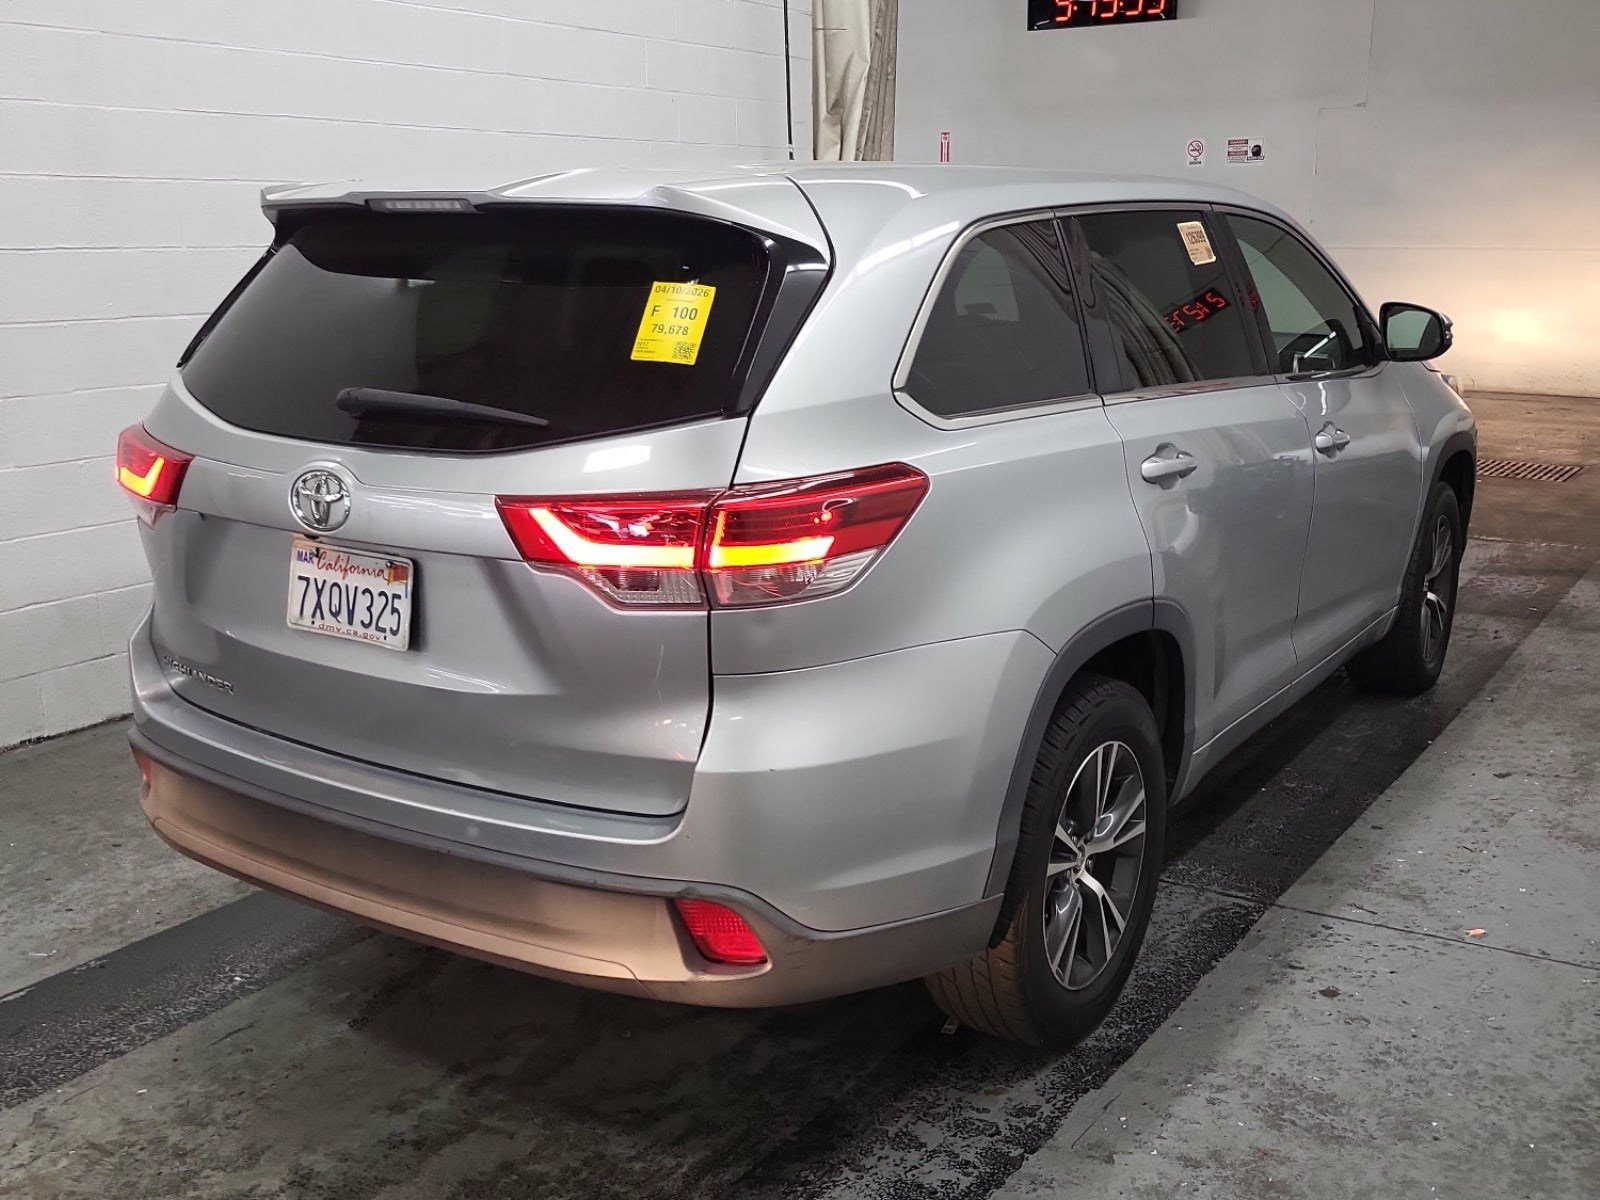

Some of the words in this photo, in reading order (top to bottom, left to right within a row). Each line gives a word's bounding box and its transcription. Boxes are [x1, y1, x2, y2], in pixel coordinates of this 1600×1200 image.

[654, 285, 710, 298] 04/10/2026
[650, 304, 662, 317] F
[672, 306, 698, 320] 100
[296, 550, 315, 564] MAR
[314, 550, 389, 581] California
[297, 574, 402, 636] 7XQV325
[318, 623, 382, 640] dmv.ca.gov
